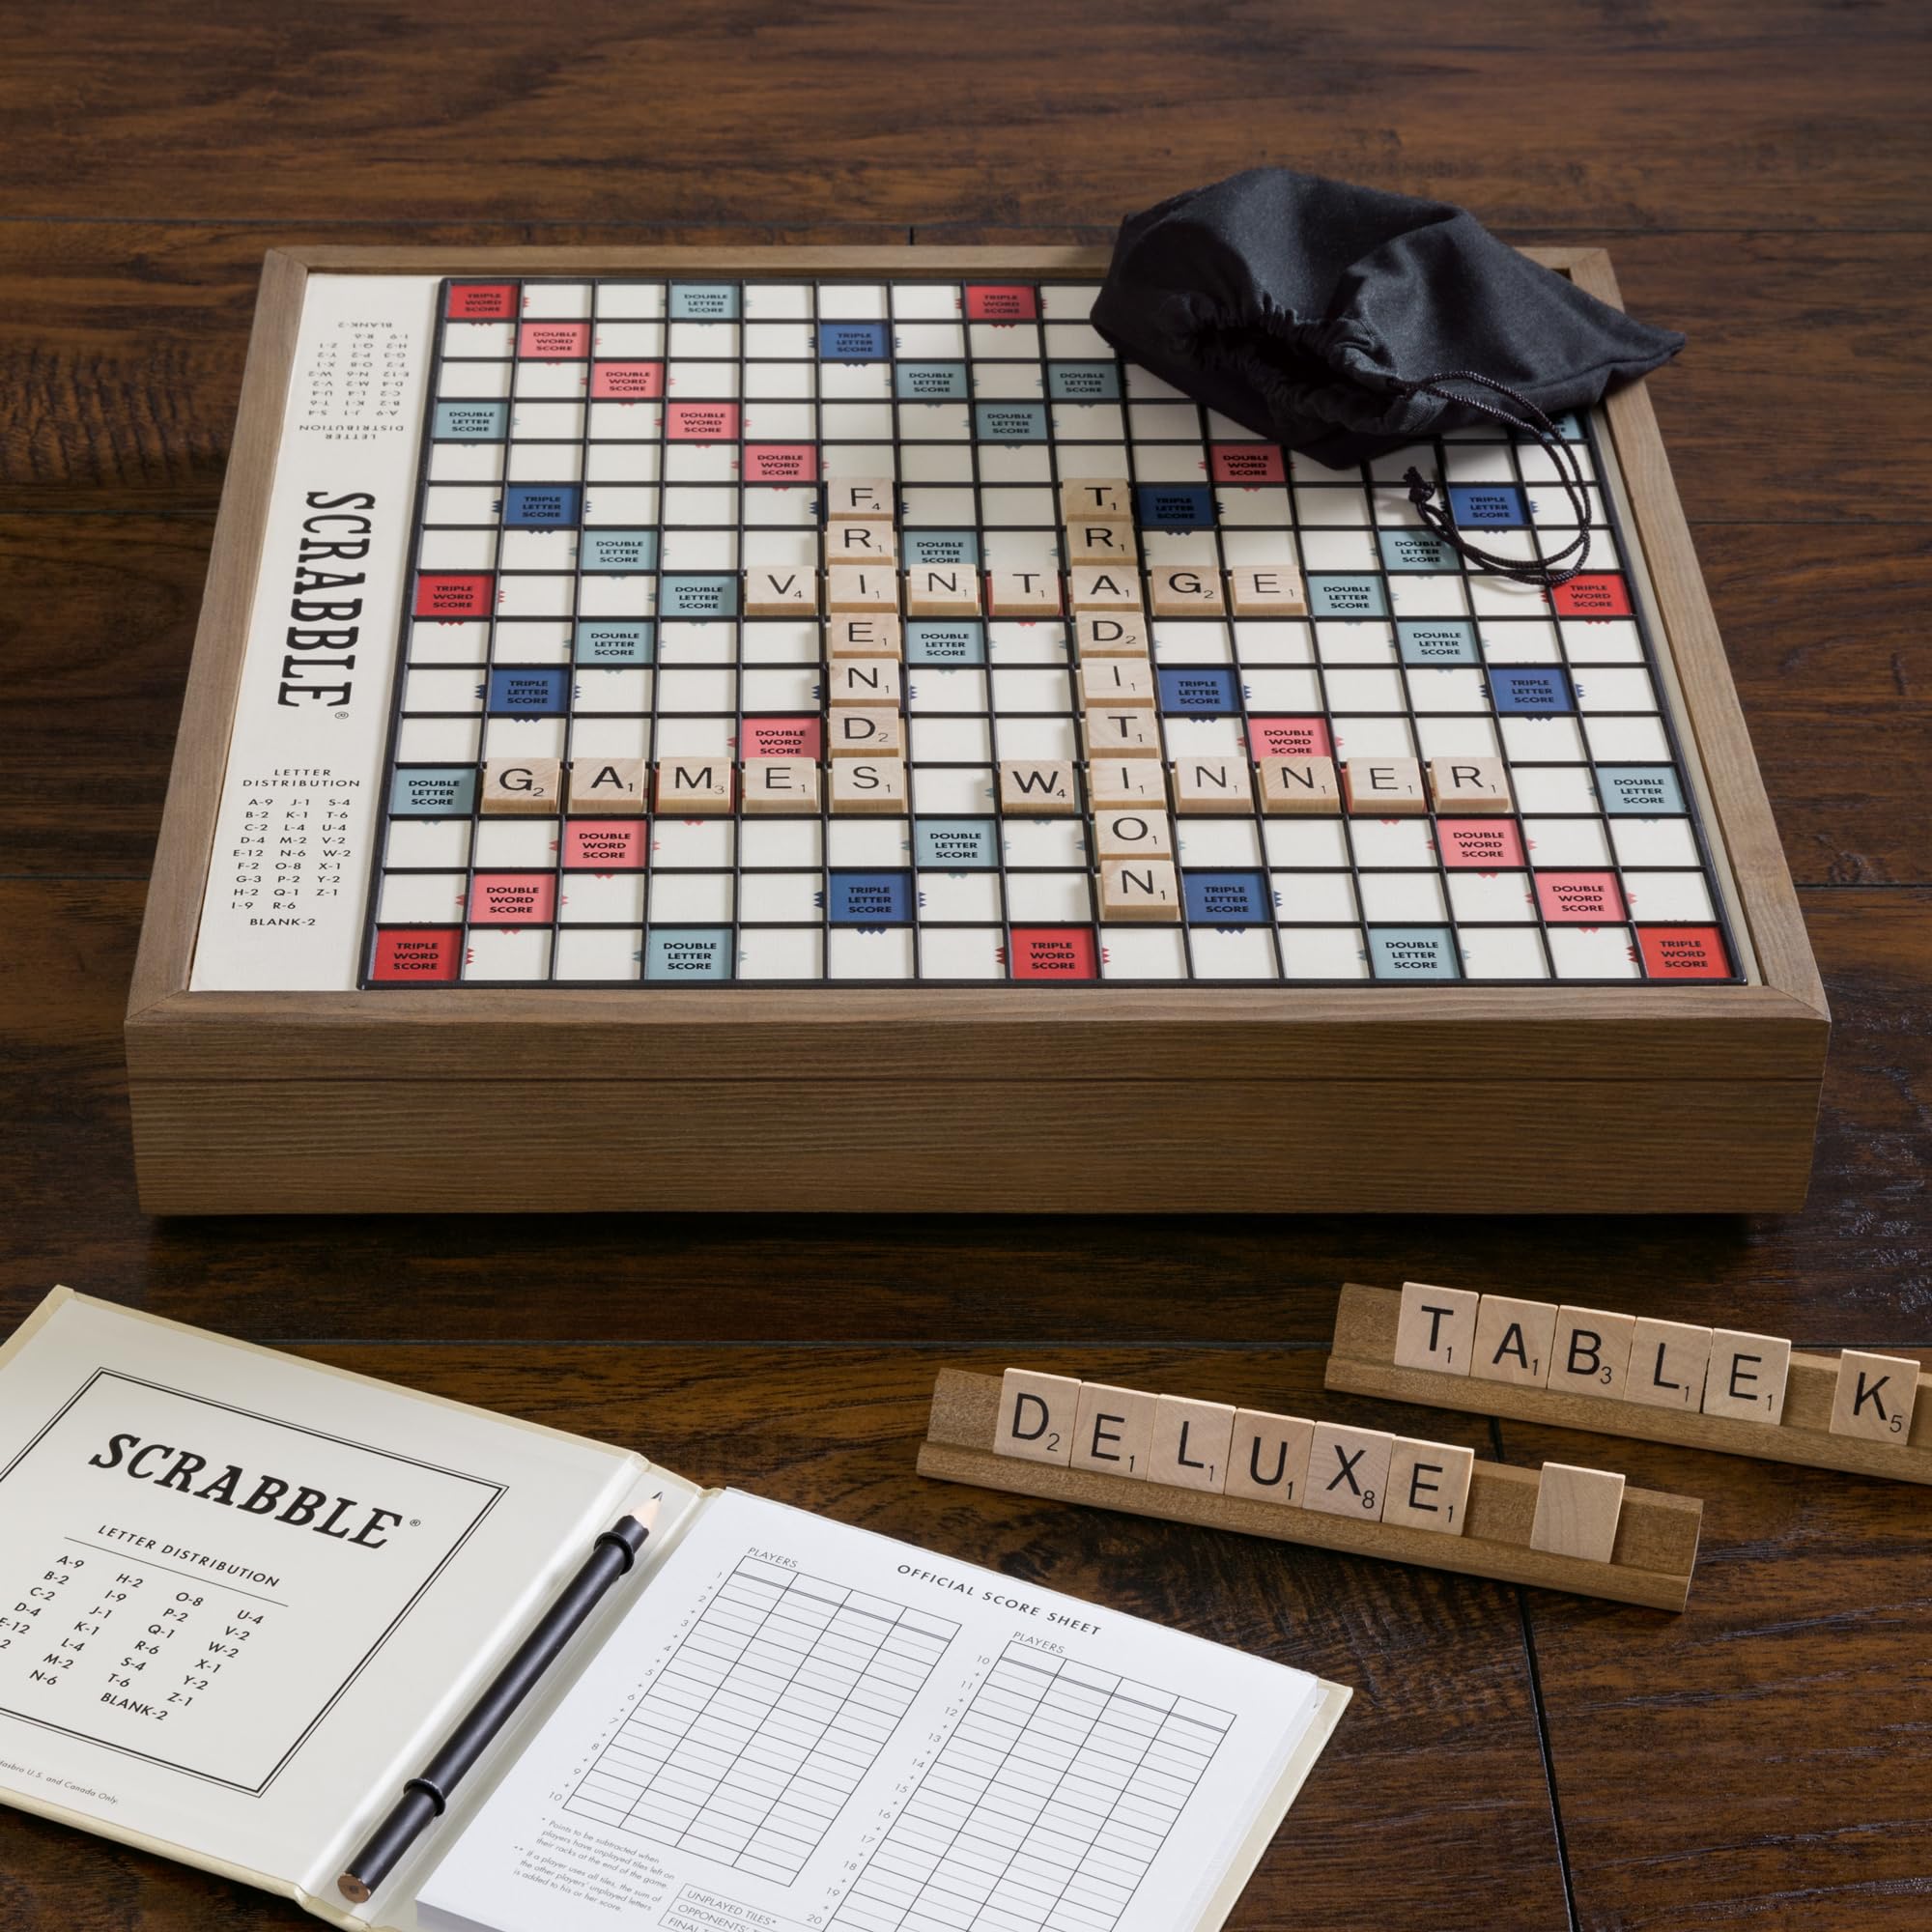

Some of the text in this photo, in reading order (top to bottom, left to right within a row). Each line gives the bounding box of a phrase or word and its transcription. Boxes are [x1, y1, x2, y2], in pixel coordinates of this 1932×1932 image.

[486, 886, 540, 895] DOUBLE
[848, 886, 890, 895] TRIPLE
[489, 895, 535, 904] WORD
[847, 895, 892, 904] LETTER
[848, 905, 893, 914] SCORE
[396, 942, 439, 951] TRIPLE
[663, 942, 717, 951] DOUBLE
[1385, 941, 1438, 950] DOUBLE
[393, 952, 440, 960] WORD
[1029, 952, 1075, 960] WORD
[1661, 950, 1707, 958] WORD
[393, 962, 438, 971] SCORE
[667, 962, 712, 971] SCORE
[1031, 961, 1075, 970] SCORE
[98, 1525, 280, 1587] LETTER DISTRIBUTION
[748, 1547, 799, 1569] PLAYERS
[56, 1555, 264, 1625] A-9 H-2 O-8 U-4
[897, 1564, 1102, 1636] OFFICIAL SCORE SHEET
[43, 1571, 250, 1641] B-2 I-9 P-2 V-2
[30, 1587, 239, 1658] C-2 J-1 Q-1 W-2
[14, 1603, 221, 1673] D-4 K-1 R-6 X-1
[1012, 1631, 1065, 1654] PLAYERS
[61, 1638, 85, 1652] L-4
[121, 1657, 147, 1671] S-4
[184, 1675, 209, 1690] Y-2
[977, 1655, 990, 1665] 10
[43, 1654, 193, 1706] M-2 T-6 Z-1
[29, 1669, 168, 1720] N-6 BLANK-2
[945, 1706, 958, 1717] 12
[928, 1732, 942, 1743] 13
[912, 1758, 925, 1769] 14
[45, 1776, 63, 1786] and
[64, 1780, 96, 1797] Canada
[895, 1783, 908, 1794] 15
[549, 1791, 562, 1802] 10
[541, 1831, 571, 1844] players
[573, 1839, 592, 1851] have
[594, 1848, 633, 1864] unplayed
[582, 1832, 594, 1841] be
[595, 1837, 638, 1856] subtracted
[639, 1853, 660, 1863] when
[588, 1856, 601, 1865] the
[602, 1861, 619, 1871] end
[687, 1889, 743, 1916] UNPLAYED
